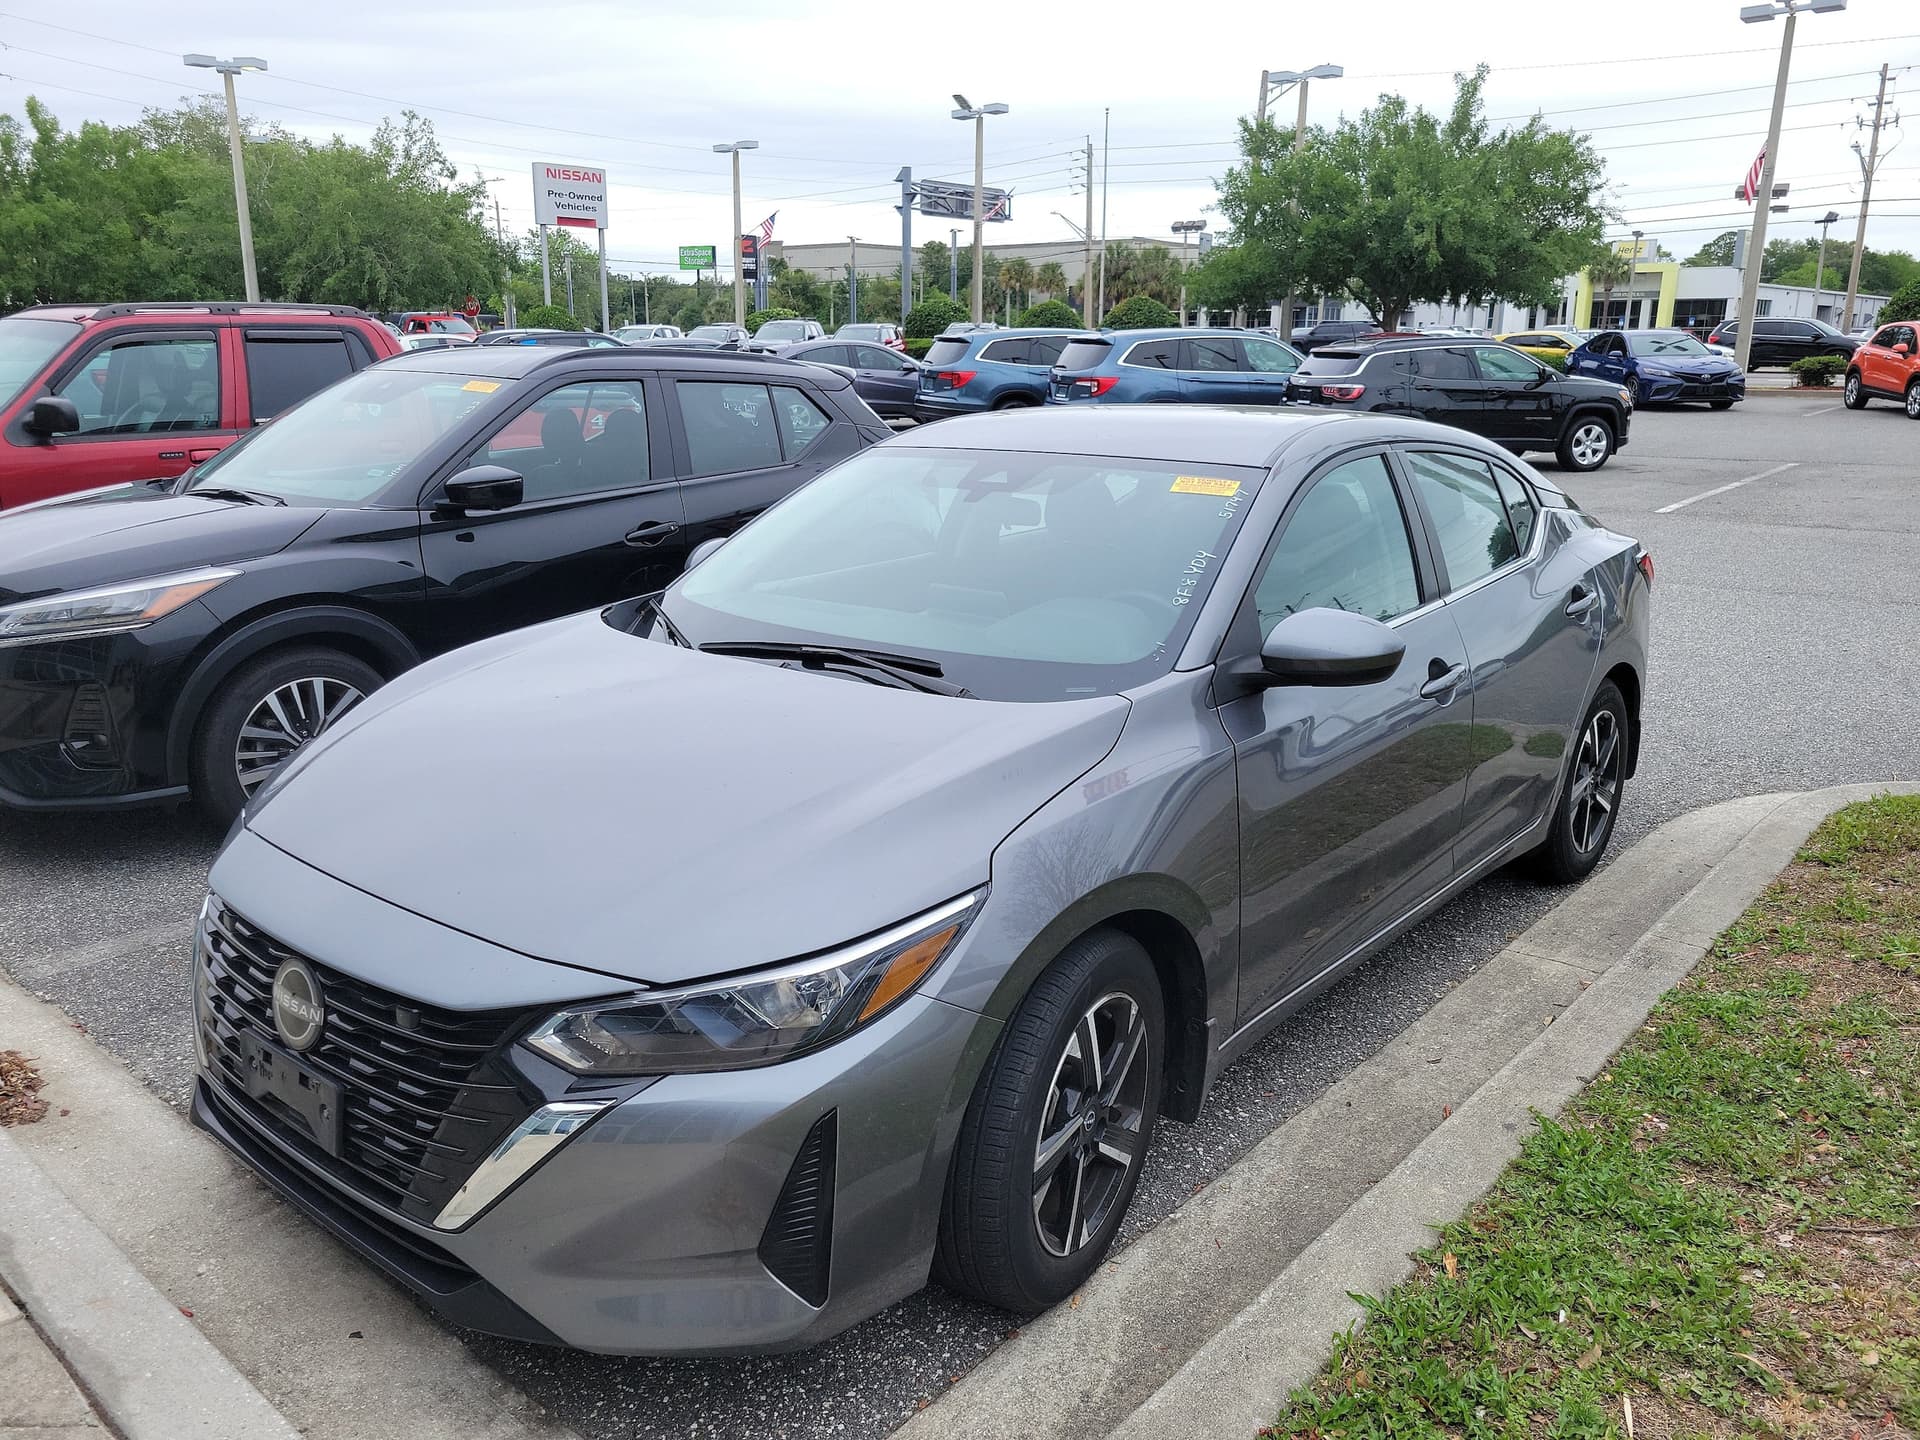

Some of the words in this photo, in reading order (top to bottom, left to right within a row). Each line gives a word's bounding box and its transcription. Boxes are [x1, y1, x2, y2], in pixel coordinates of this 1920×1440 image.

[546, 168, 602, 184] NISSAN
[547, 189, 603, 202] Pre-Owned
[554, 201, 598, 212] Vehicles
[1617, 246, 1643, 254] Herz
